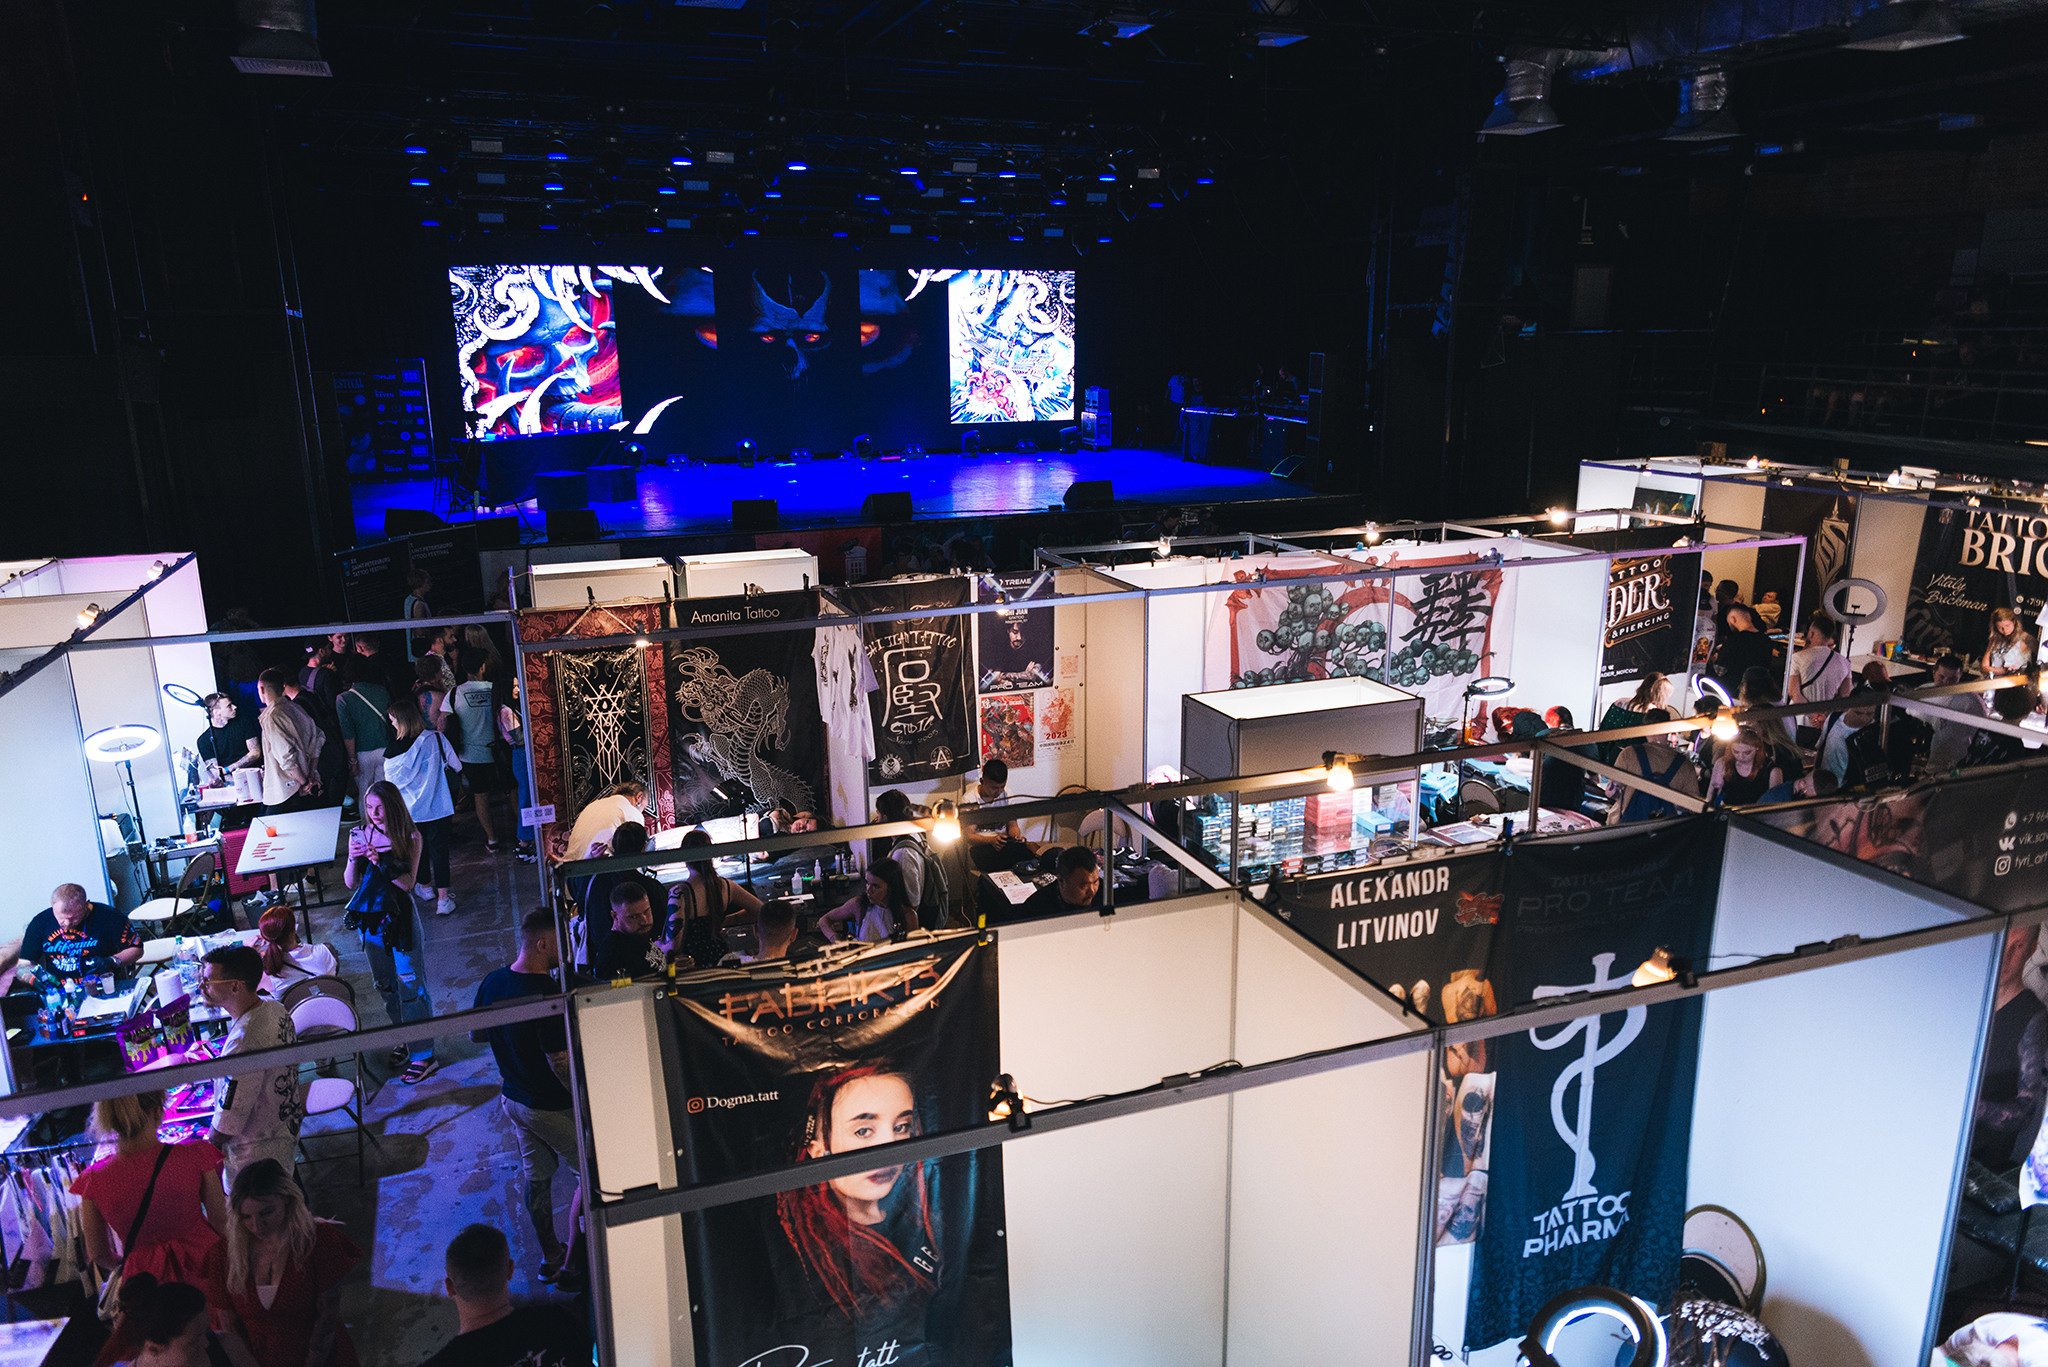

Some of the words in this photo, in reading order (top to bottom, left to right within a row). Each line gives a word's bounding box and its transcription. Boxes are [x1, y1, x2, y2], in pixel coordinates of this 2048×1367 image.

[352, 568, 370, 577] TATTOO
[1926, 573, 1967, 596] Vitaly
[1925, 590, 1988, 612] Brickman
[690, 610, 741, 623] Amanita
[743, 606, 780, 619] Tattoo
[989, 680, 1014, 691] PRO
[1016, 680, 1043, 688] TEAM
[1046, 730, 1067, 740] 2023
[1330, 866, 1450, 909] ALEXANDR
[1518, 891, 1591, 917] PRO
[1607, 867, 1694, 906] TEAM
[1336, 908, 1440, 950] LITVINOV
[42, 937, 98, 954] California
[707, 1090, 779, 1109] Dogma.tatt
[1533, 1190, 1632, 1236] TATTOO
